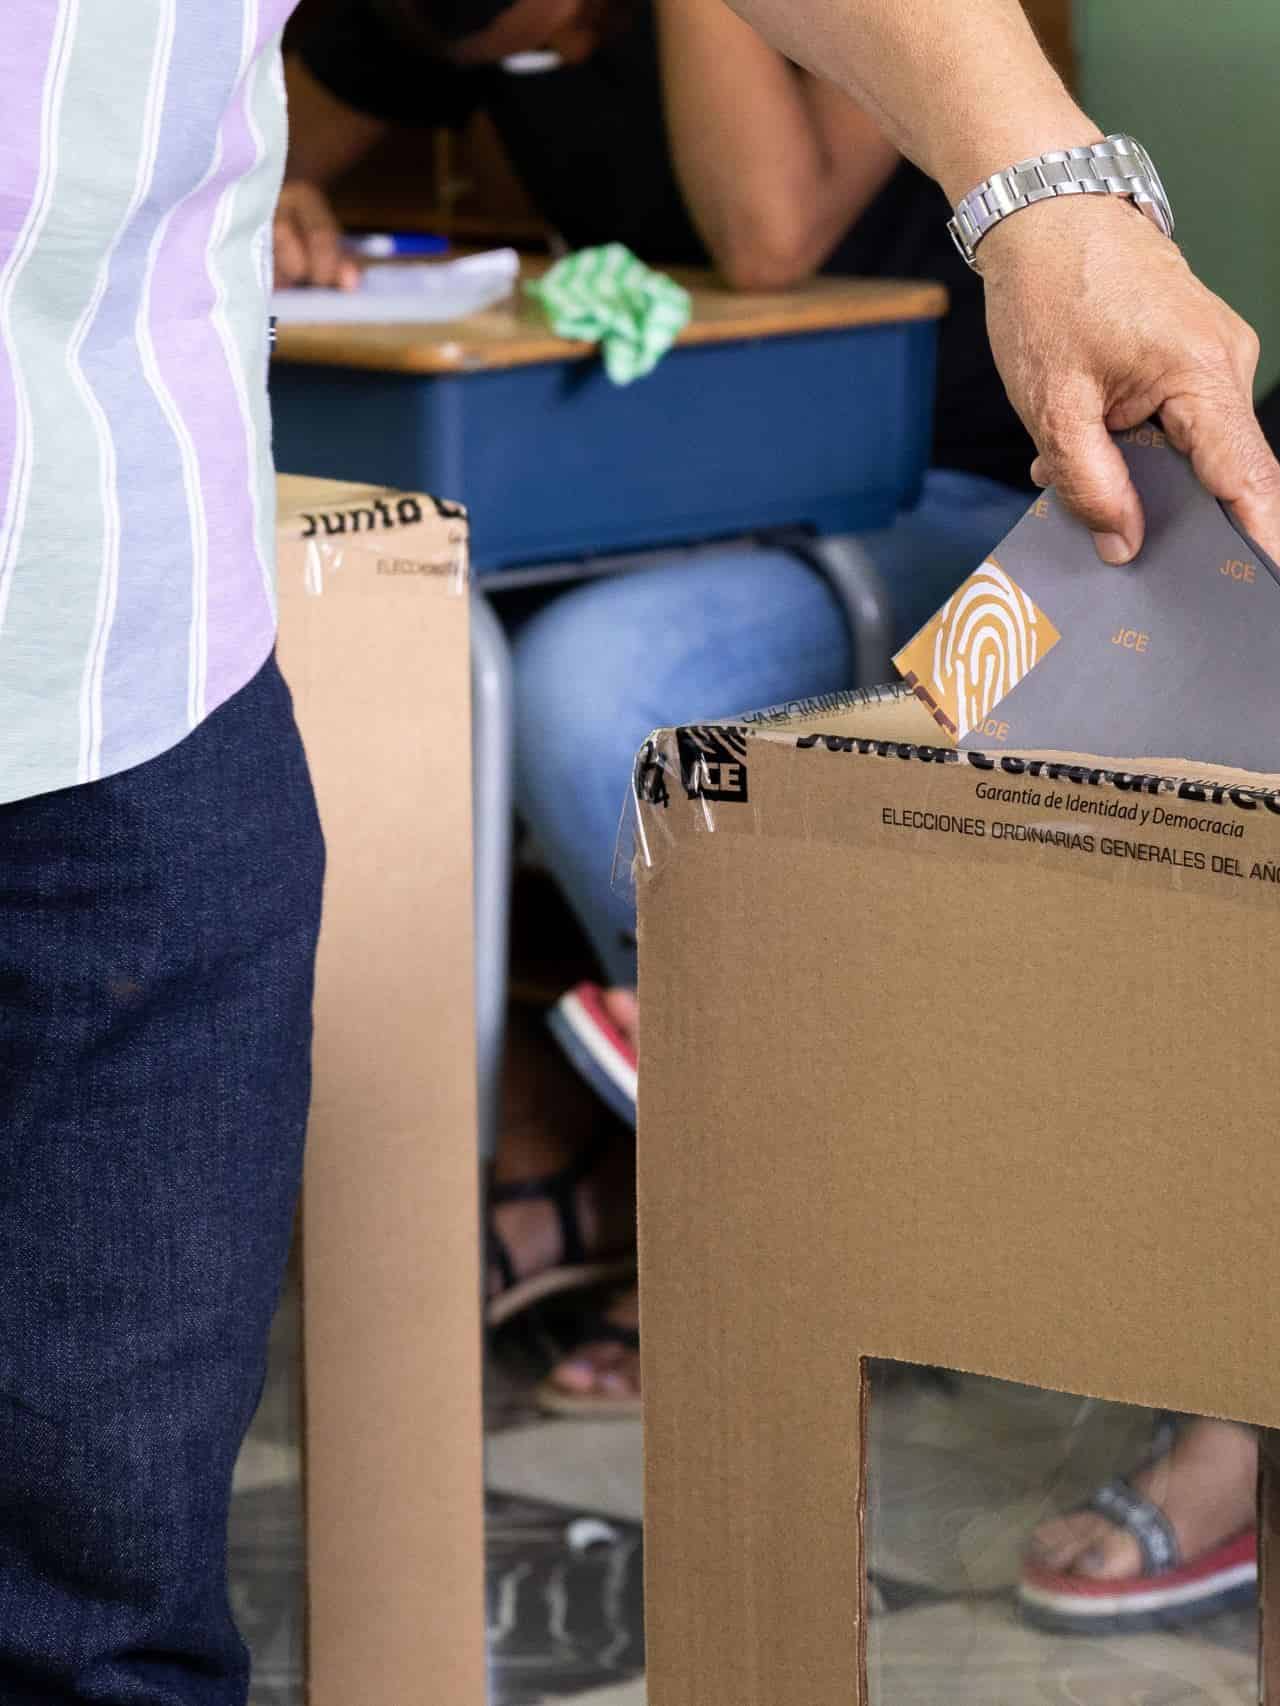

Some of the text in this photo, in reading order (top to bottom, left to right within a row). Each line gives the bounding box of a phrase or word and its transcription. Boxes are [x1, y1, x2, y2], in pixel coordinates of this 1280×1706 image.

[1124, 430, 1166, 450] JCE
[1219, 558, 1258, 584] JCE
[1111, 626, 1151, 654] JCE
[1044, 791, 1064, 810] de
[1065, 794, 1139, 821] Identidad
[1138, 808, 1151, 826] y
[1151, 807, 1246, 838] Democracia
[881, 807, 986, 837] ELECCIONES
[991, 821, 1096, 854] ORDINARIAS
[1100, 836, 1207, 871] GENERALES
[1210, 855, 1245, 878] DEL
